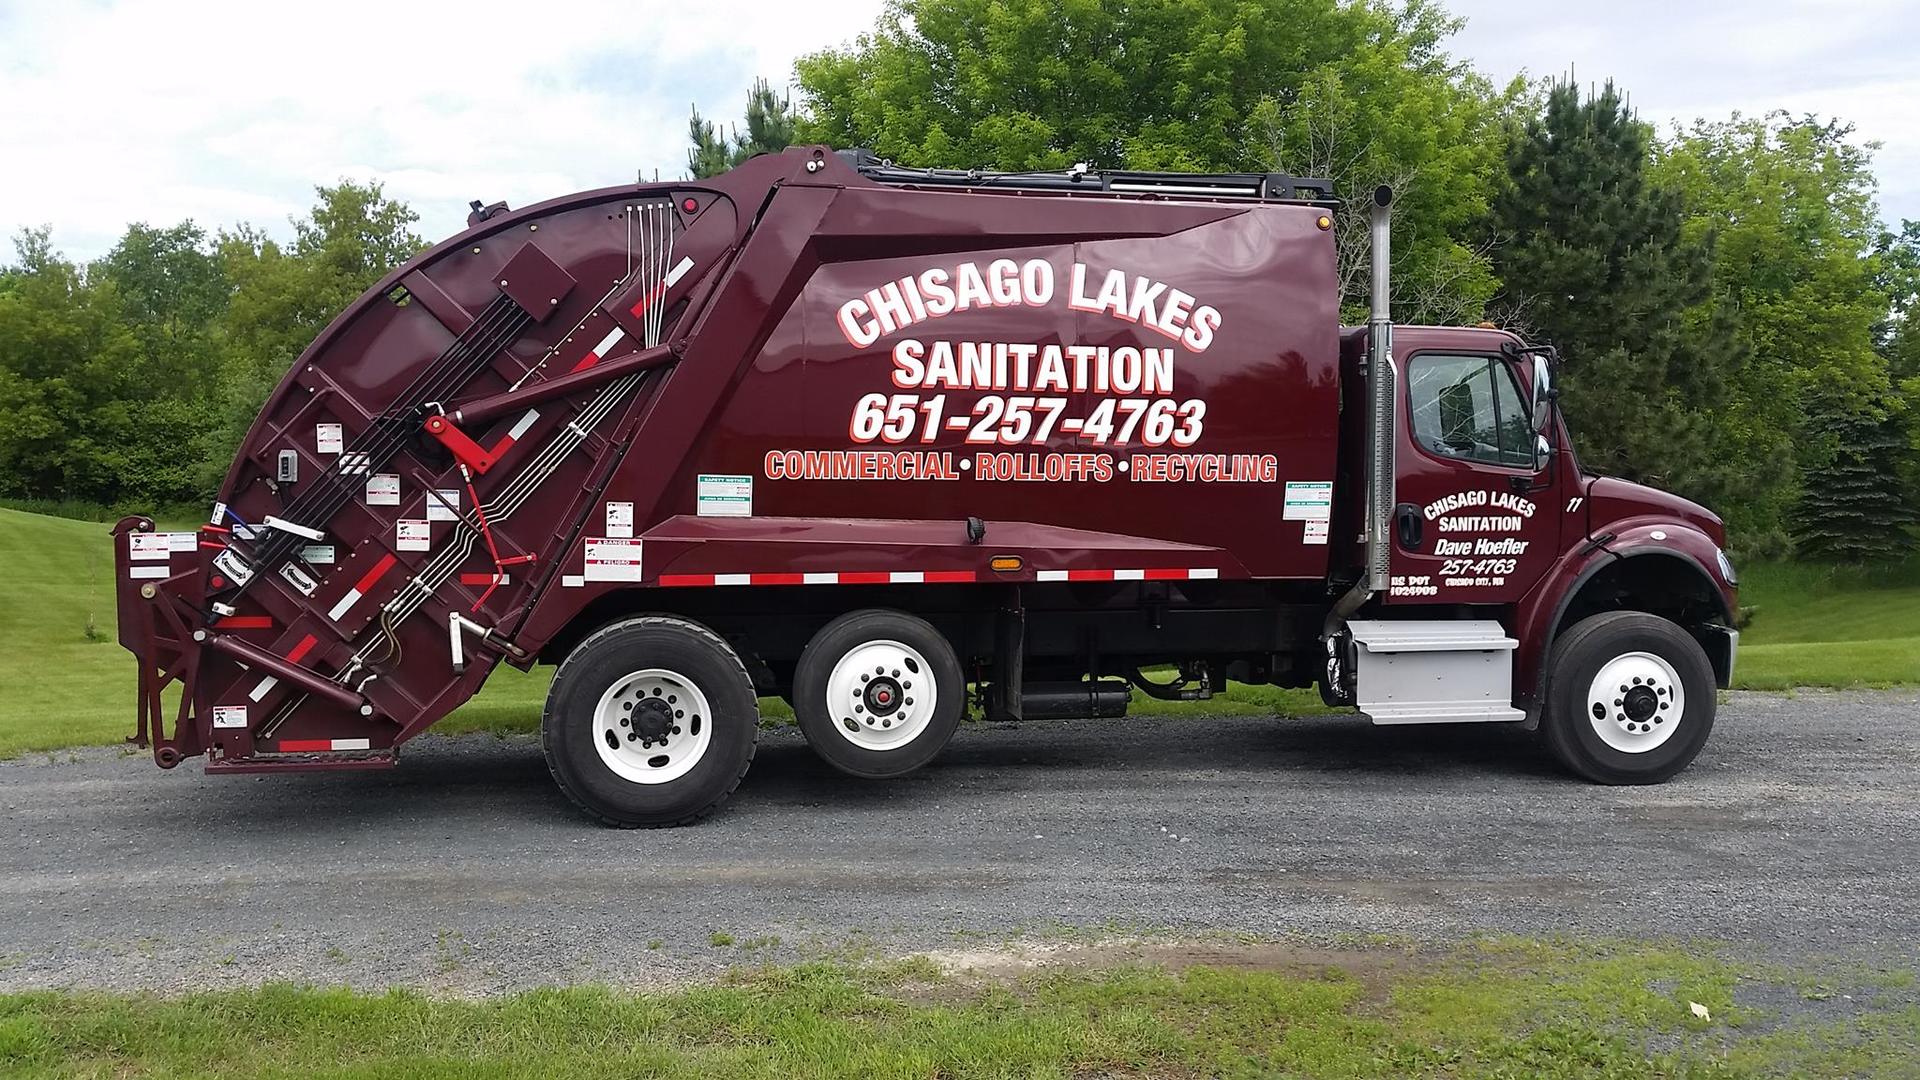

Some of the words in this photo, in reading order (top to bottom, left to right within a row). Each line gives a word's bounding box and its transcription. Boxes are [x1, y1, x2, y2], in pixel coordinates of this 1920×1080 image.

[836, 258, 1055, 349] CHISAGO
[1068, 262, 1222, 353] LAKES
[892, 340, 1174, 394] SANITATION
[848, 393, 1207, 448] 651-257-4763
[764, 450, 959, 481] COMMERCIAL
[975, 453, 1113, 482] ROLLOFFS
[1131, 454, 1278, 483] RECYCLING
[1423, 490, 1487, 521] CHISAGO
[1490, 491, 1536, 518] LAKES
[1566, 497, 1583, 512] 11
[1438, 516, 1522, 532] SANITATION
[1434, 538, 1472, 556] Dave
[1473, 538, 1529, 556] Hoefler
[1438, 559, 1517, 575] 257-4763
[1408, 576, 1430, 586] DOT
